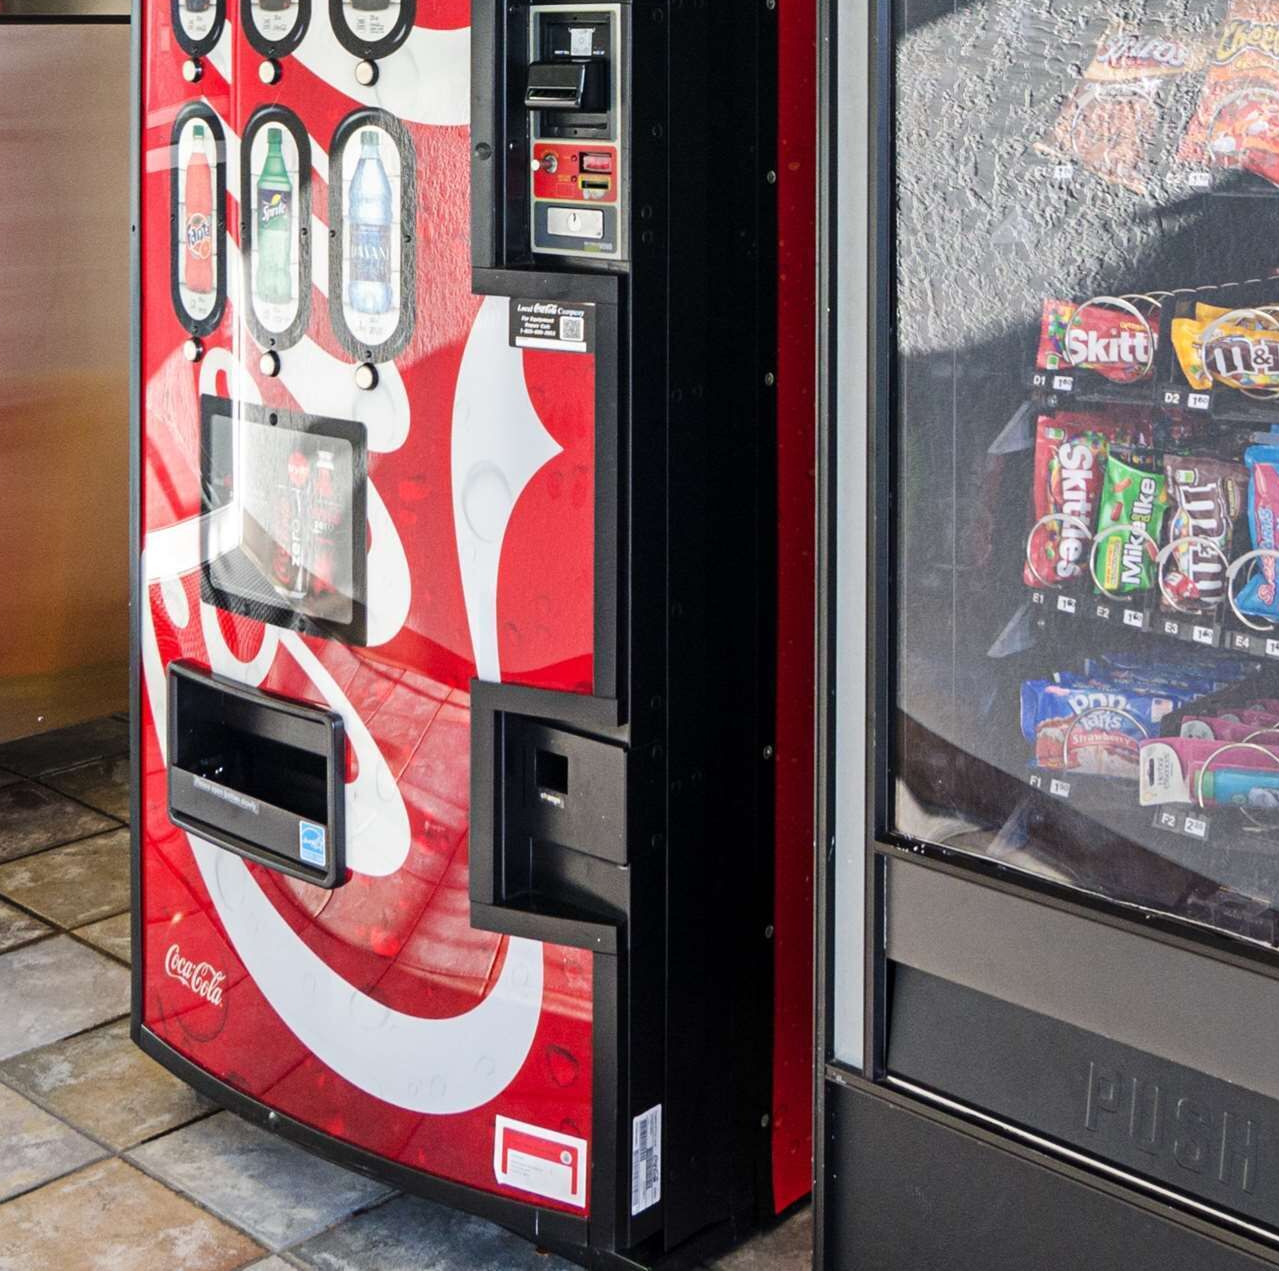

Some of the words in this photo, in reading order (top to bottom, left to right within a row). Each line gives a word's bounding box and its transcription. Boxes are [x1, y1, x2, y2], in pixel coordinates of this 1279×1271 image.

[261, 197, 287, 223] Sprite
[1033, 375, 1046, 386] D1
[1164, 393, 1180, 403] D2
[1133, 477, 1157, 515] Ike
[1056, 442, 1094, 578] Skittles
[1121, 521, 1146, 585] Mike
[1032, 592, 1045, 604] E1
[1096, 606, 1110, 619] E2
[1165, 623, 1178, 634] E3
[1236, 635, 1250, 648] E4
[1072, 732, 1139, 745] Strawberry
[1161, 813, 1176, 827] F2
[165, 943, 226, 1006] Coca-Cola
[1085, 1061, 1255, 1196] PUSH
